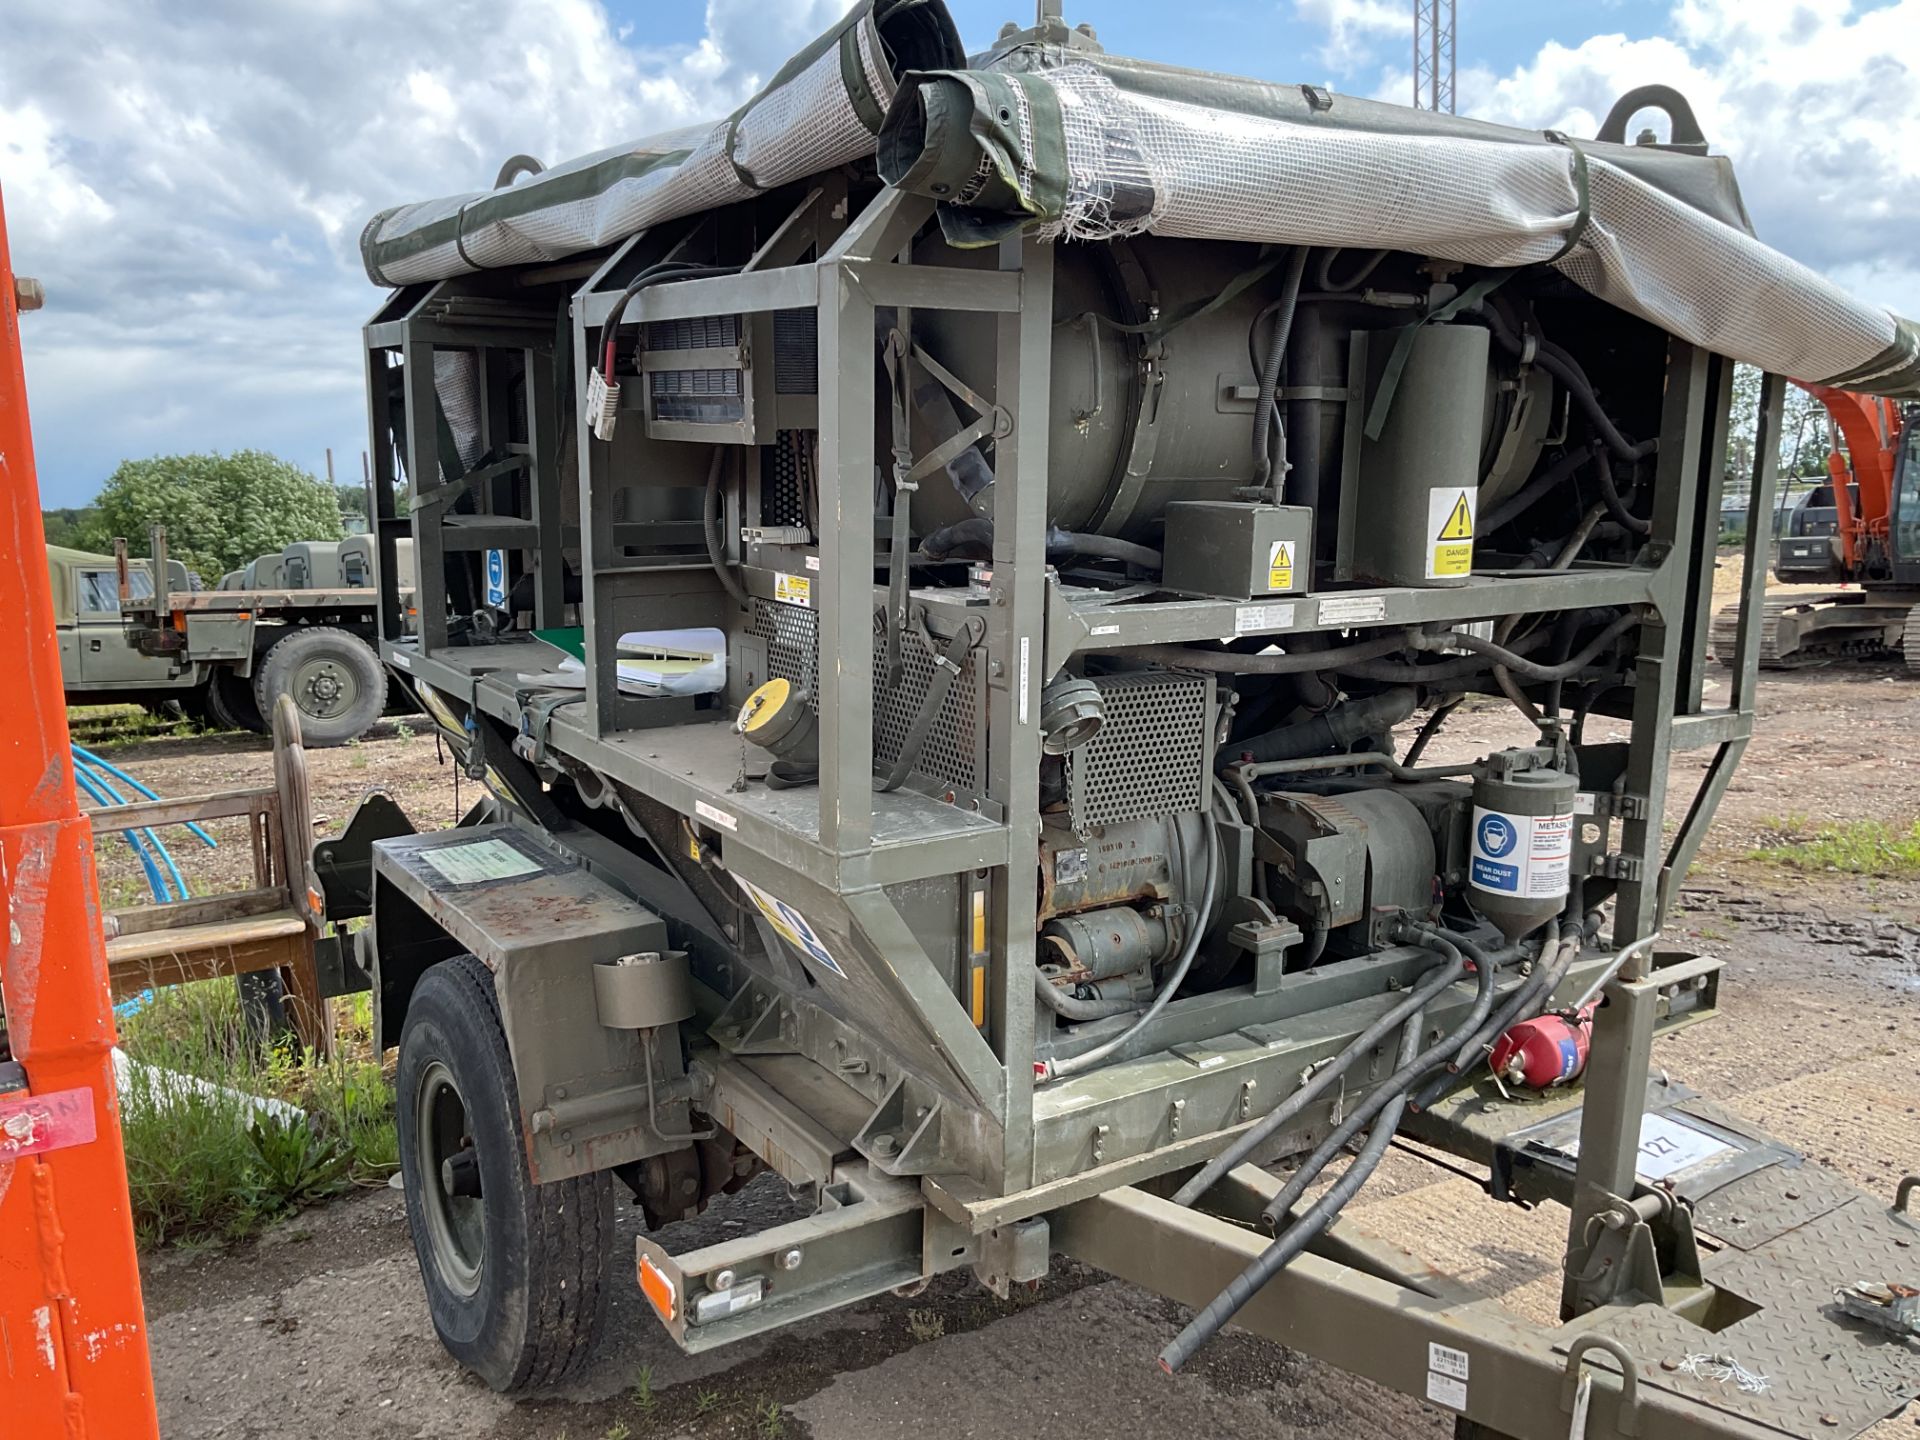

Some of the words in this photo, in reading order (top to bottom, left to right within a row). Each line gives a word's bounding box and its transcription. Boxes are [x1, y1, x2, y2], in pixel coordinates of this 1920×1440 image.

[1446, 548, 1469, 556] DANGER
[1475, 863, 1492, 874] WEAR
[1493, 868, 1512, 877] DUST
[1482, 873, 1501, 883] MASK
